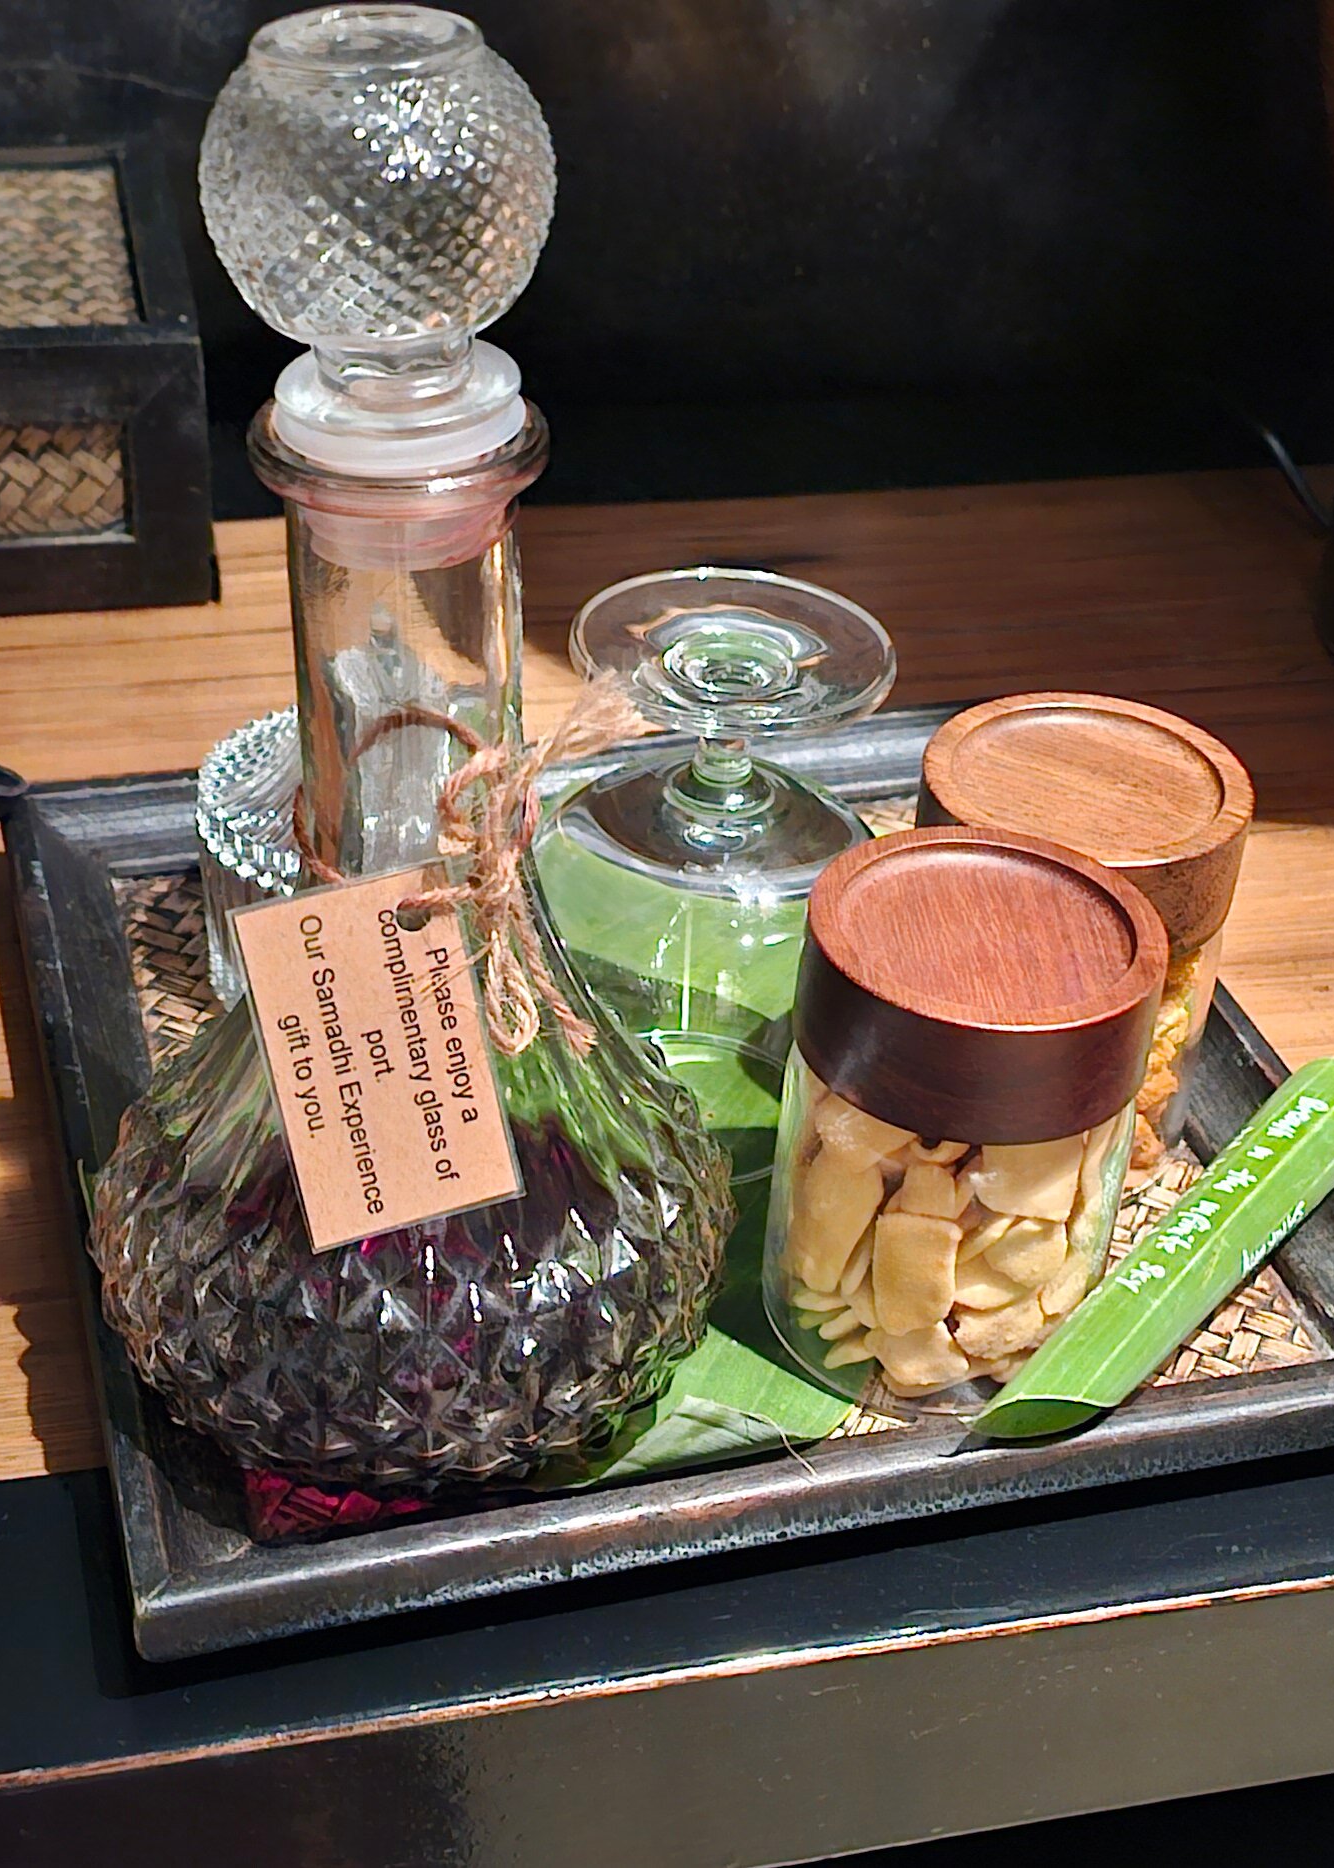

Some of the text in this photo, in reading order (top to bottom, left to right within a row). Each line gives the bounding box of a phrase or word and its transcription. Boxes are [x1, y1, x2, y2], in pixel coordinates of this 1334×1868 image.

[277, 1013, 326, 1140] gift to you.
[298, 913, 385, 1216] Our Samadhi Experience
[360, 1028, 396, 1084] port.
[377, 909, 461, 1182] complimentary glass of
[445, 1036, 475, 1100] enjoy
[461, 1106, 479, 1125] a
